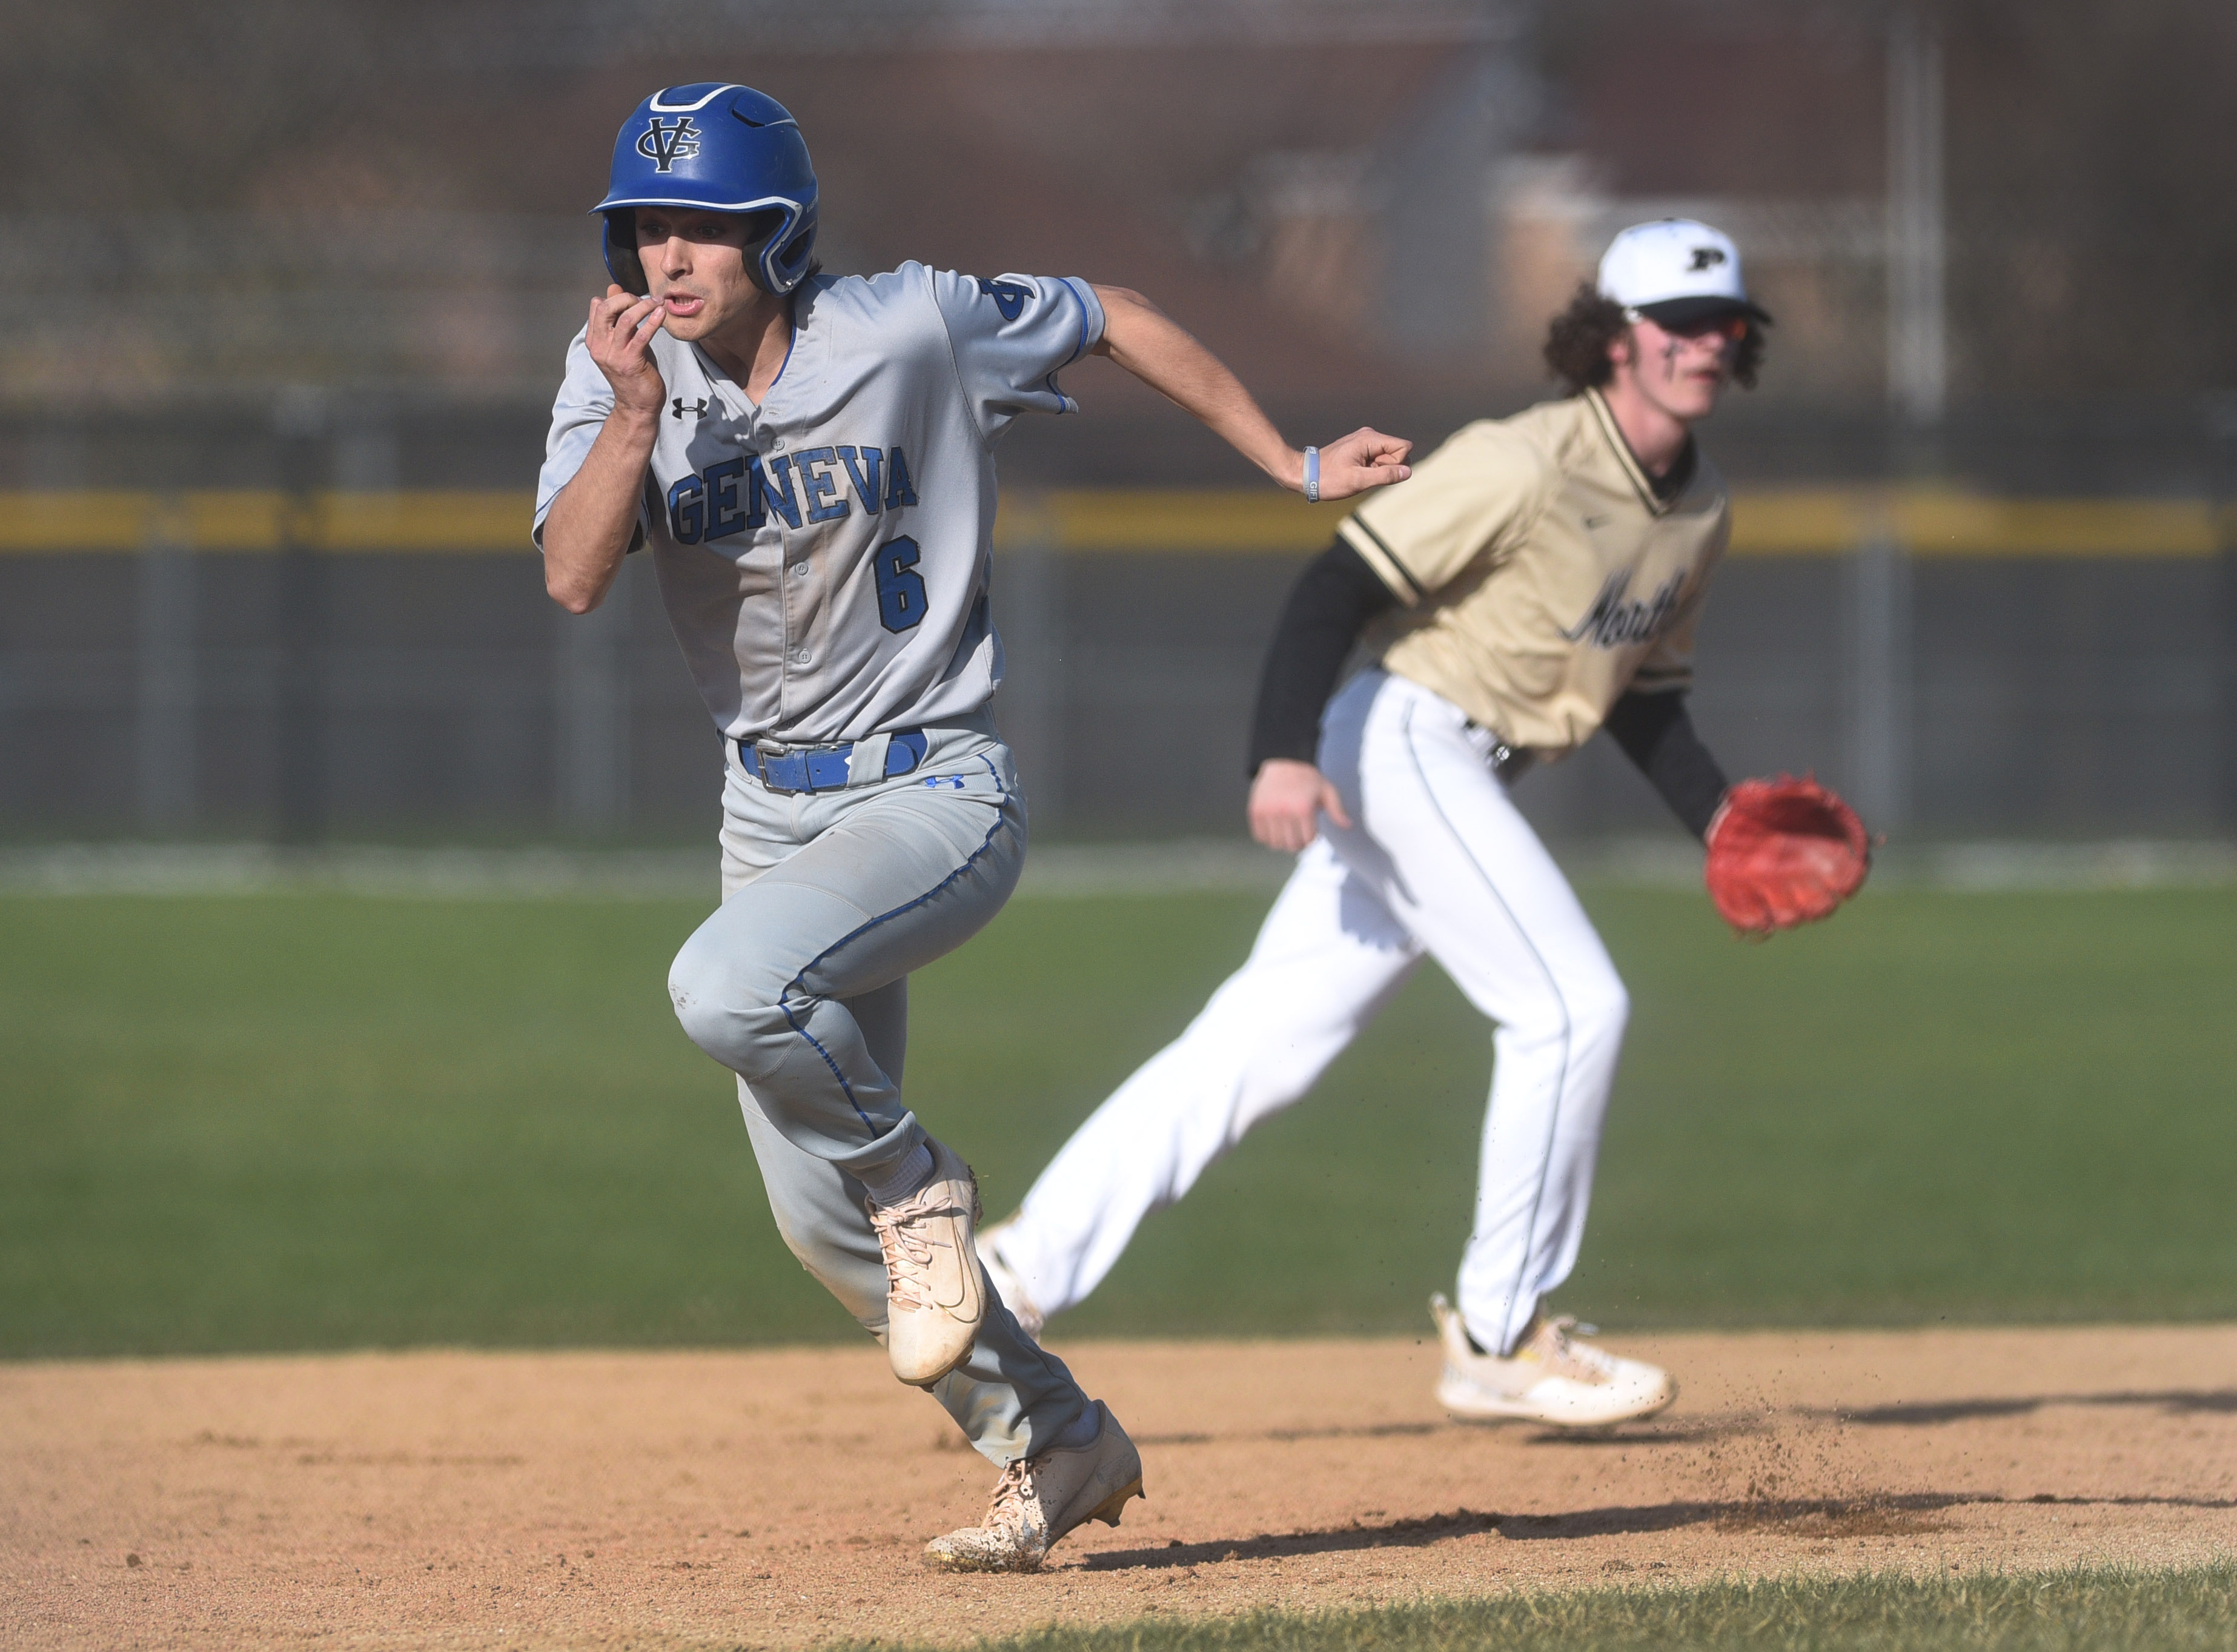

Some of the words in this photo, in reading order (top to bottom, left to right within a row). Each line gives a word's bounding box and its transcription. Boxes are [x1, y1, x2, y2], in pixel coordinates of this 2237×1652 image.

[1687, 247, 1725, 272] P
[667, 445, 918, 545] GENEVA
[873, 534, 929, 635] 6
